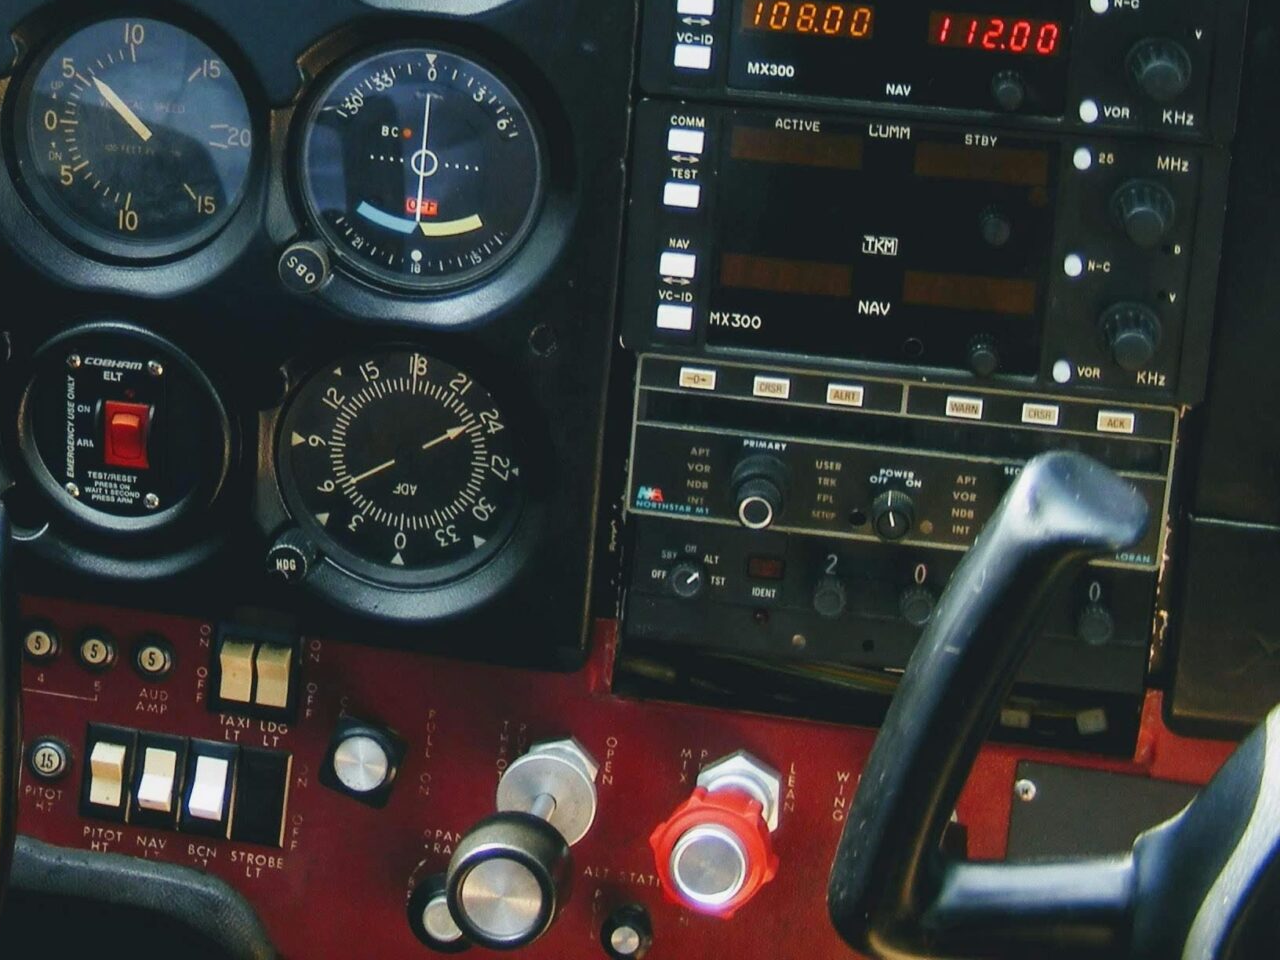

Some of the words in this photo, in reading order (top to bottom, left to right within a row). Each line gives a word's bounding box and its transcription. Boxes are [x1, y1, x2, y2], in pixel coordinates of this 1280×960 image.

[753, 1, 871, 37] 108.00
[124, 23, 145, 45] 10
[676, 32, 713, 45] VC-ID
[940, 18, 1058, 53] 112.00
[202, 60, 221, 78] 15
[747, 61, 795, 78] MX300
[375, 72, 393, 91] 33
[886, 83, 911, 96] NAV
[345, 95, 363, 115] 30
[1103, 105, 1130, 119] VOR
[670, 115, 705, 128] COMM
[775, 118, 821, 132] ACTIVE
[1162, 110, 1195, 126] KHz
[227, 128, 251, 147] 20
[965, 134, 998, 147] STBY
[1157, 155, 1189, 172] MHz
[60, 165, 73, 186] 5
[671, 168, 698, 180] TEST
[197, 196, 216, 214] 15
[119, 210, 138, 231] 10
[669, 238, 690, 250] NAV
[470, 254, 481, 265] 15
[286, 256, 316, 285] OBS
[658, 289, 693, 303] VC-ID
[858, 300, 891, 316] NAV
[709, 312, 762, 330] MX300
[84, 357, 143, 371] COBHAM
[103, 371, 123, 382] ELT
[359, 361, 380, 382] 15
[1077, 366, 1101, 378] VOR
[1136, 370, 1166, 387] KHz
[67, 375, 75, 400] ONLY
[449, 373, 473, 395] 21
[322, 388, 345, 410] 12
[833, 391, 856, 401] ALRT
[67, 400, 75, 420] USE
[950, 403, 979, 415] WARN
[479, 409, 504, 435] 24
[1106, 418, 1125, 428] ACK
[67, 420, 75, 478] EMERGENCY
[690, 447, 711, 456] APT
[743, 439, 787, 451] PRIMARY
[491, 454, 510, 481] 27
[687, 463, 711, 473] VOR
[815, 460, 842, 471] USER
[87, 470, 138, 484] TEST/RESET
[879, 467, 915, 480] POWER
[956, 475, 977, 486] APT
[95, 480, 118, 489] PRESS
[393, 483, 418, 495] ADF
[687, 479, 709, 489] NDB
[817, 477, 837, 487] TRK
[84, 486, 103, 494] WAIT
[110, 489, 140, 499] SECOND
[92, 494, 115, 503] PRESS
[816, 494, 833, 504] FPL
[952, 491, 977, 502] VOR
[472, 496, 496, 522] 30
[636, 500, 691, 512] NORTHSTAR
[951, 508, 974, 520] NDB
[434, 525, 461, 547] 33
[952, 524, 971, 536] INT
[276, 558, 296, 571] HDG
[704, 554, 719, 564] ALT
[1115, 553, 1151, 563] LORAN
[651, 569, 666, 579] OFF
[711, 576, 726, 586] TST
[752, 587, 776, 599] IDENT
[139, 688, 169, 701] AUD
[136, 701, 168, 715] AMP
[220, 714, 251, 729] TAXI
[260, 720, 289, 735] LDG
[601, 736, 618, 785] OPEN
[25, 785, 63, 800] PITOT
[832, 771, 850, 821] WING
[83, 826, 123, 843] PITOT
[137, 835, 167, 849] NAV
[188, 844, 218, 859] BCN
[230, 850, 284, 869] STROBE
